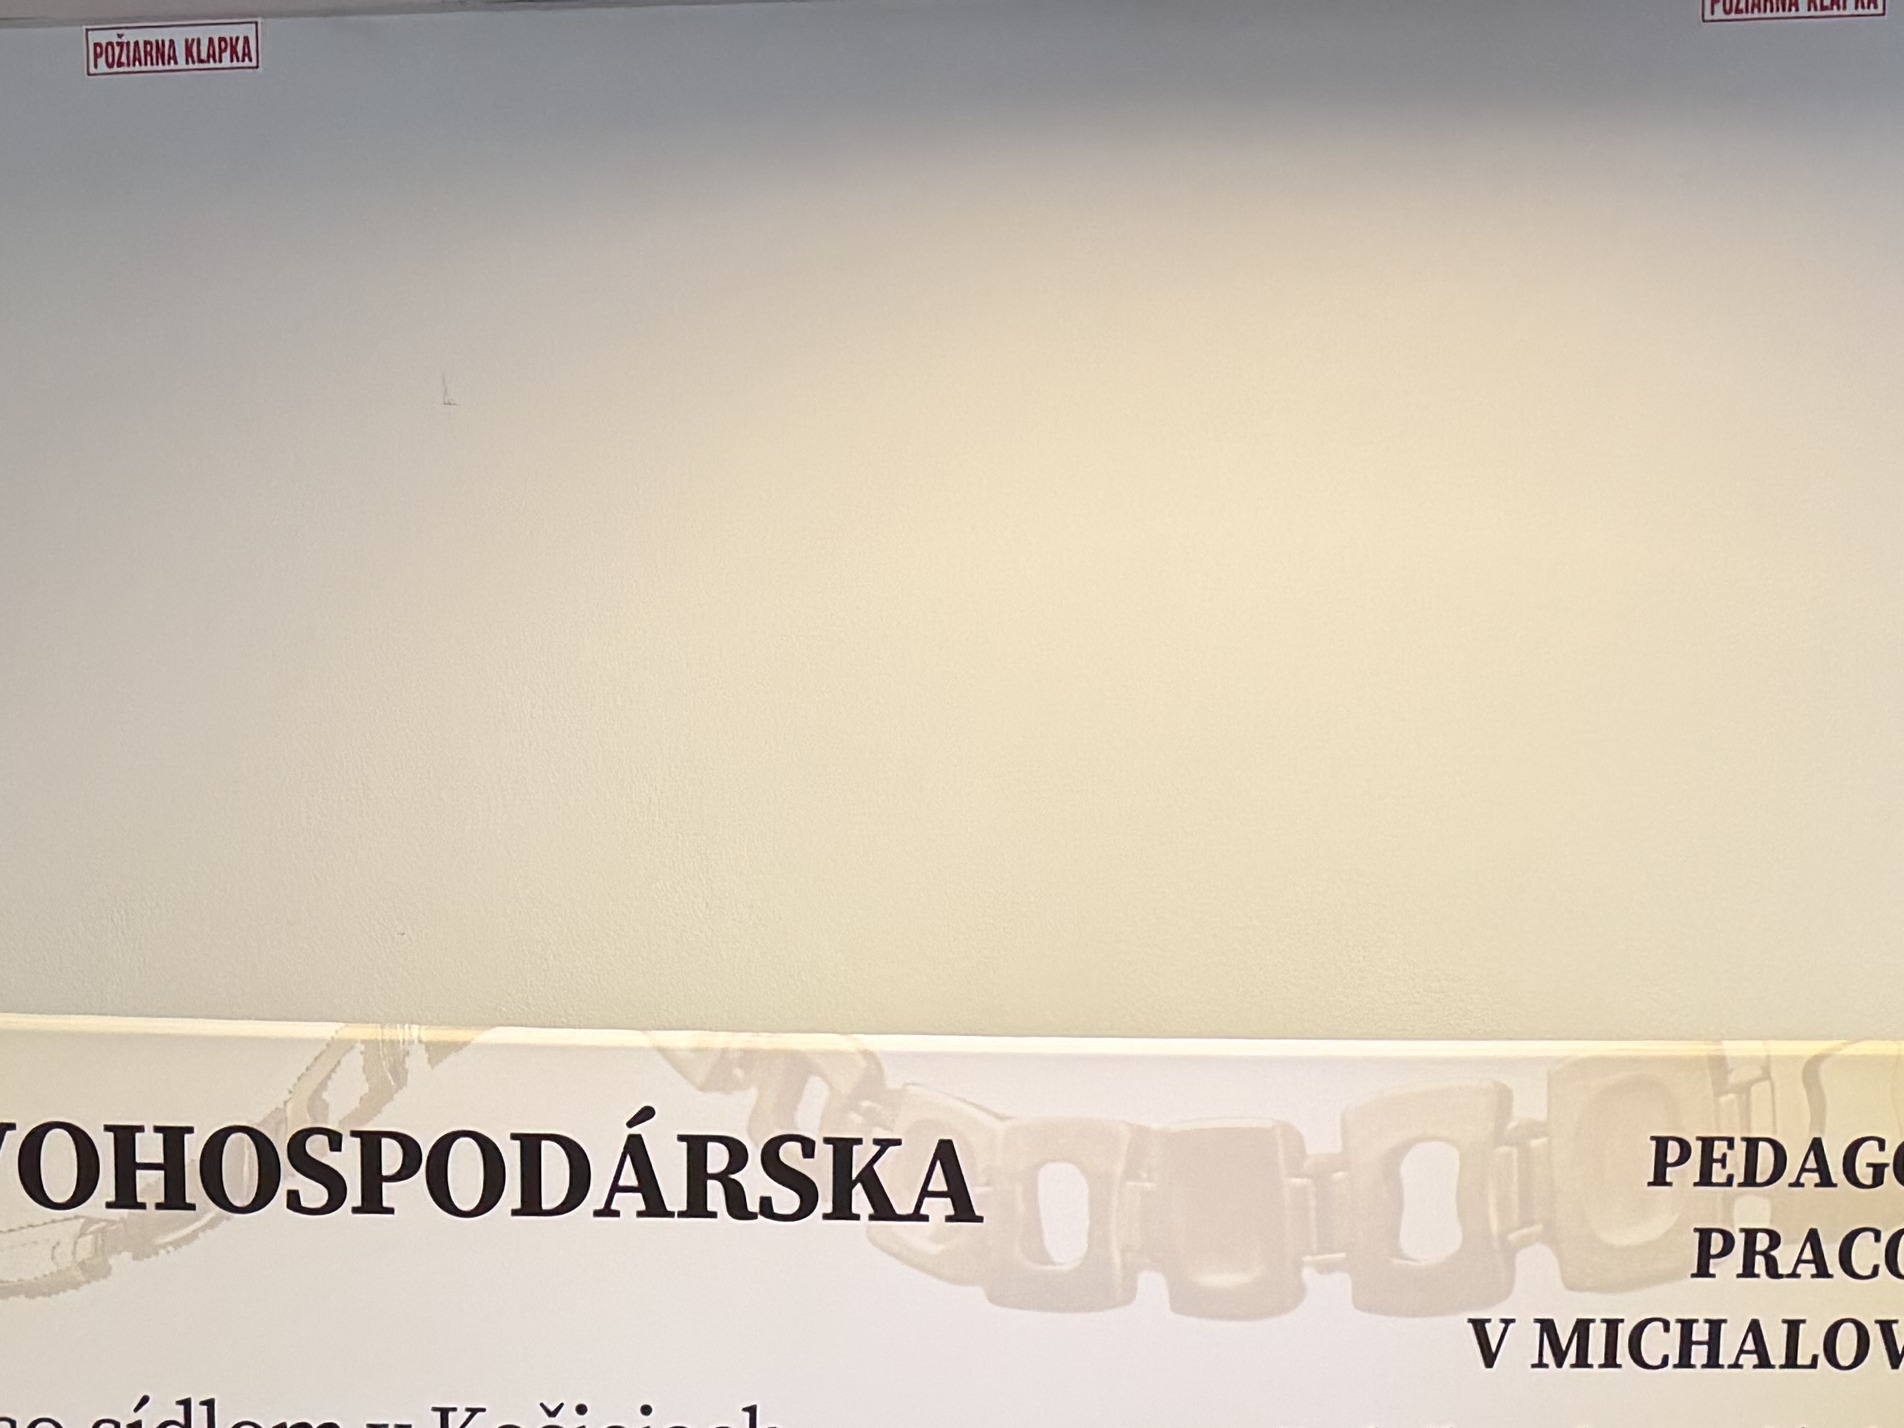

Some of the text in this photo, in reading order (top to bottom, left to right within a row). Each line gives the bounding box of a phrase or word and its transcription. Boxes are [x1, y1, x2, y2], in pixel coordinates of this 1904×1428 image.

[93, 32, 253, 69] POŽIARNA KLAPKA
[1467, 1317, 1514, 1370] V
